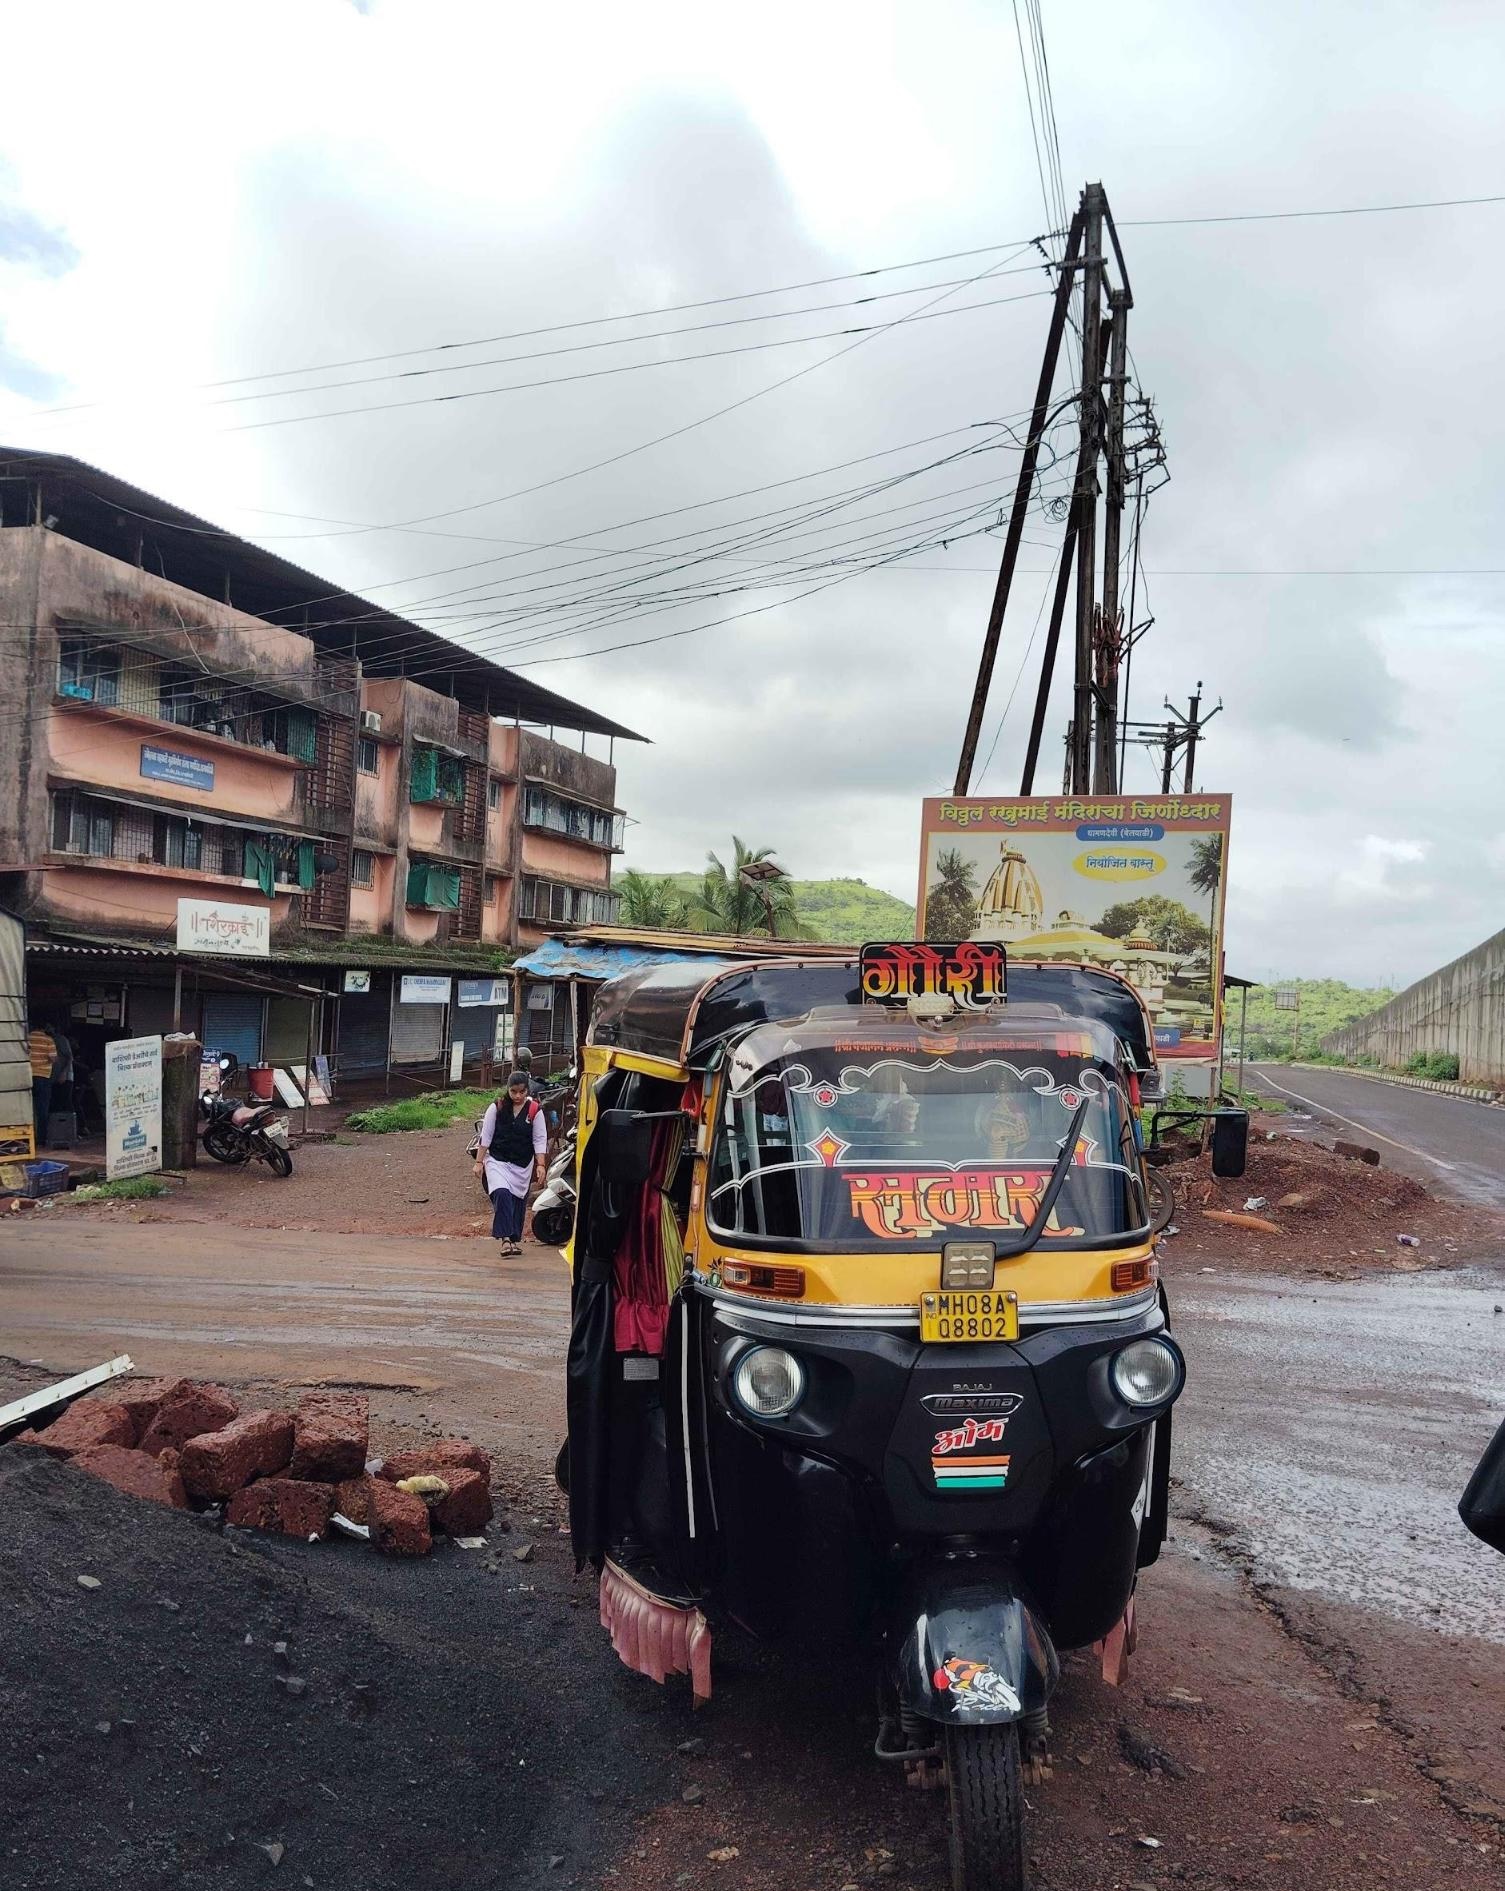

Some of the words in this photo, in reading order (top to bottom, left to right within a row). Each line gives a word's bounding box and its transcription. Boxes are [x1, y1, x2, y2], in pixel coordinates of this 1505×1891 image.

[989, 800, 1050, 827] रखुमाई
[1054, 800, 1126, 821] मंदिराचा
[1086, 855, 1127, 869] नियोजित
[863, 943, 1008, 1012] गौरी
[938, 1294, 1005, 1315] MH08A
[939, 1317, 1006, 1338] Q8802
[952, 1383, 993, 1392] BAJAJ
[933, 1397, 1014, 1409] Maxima
